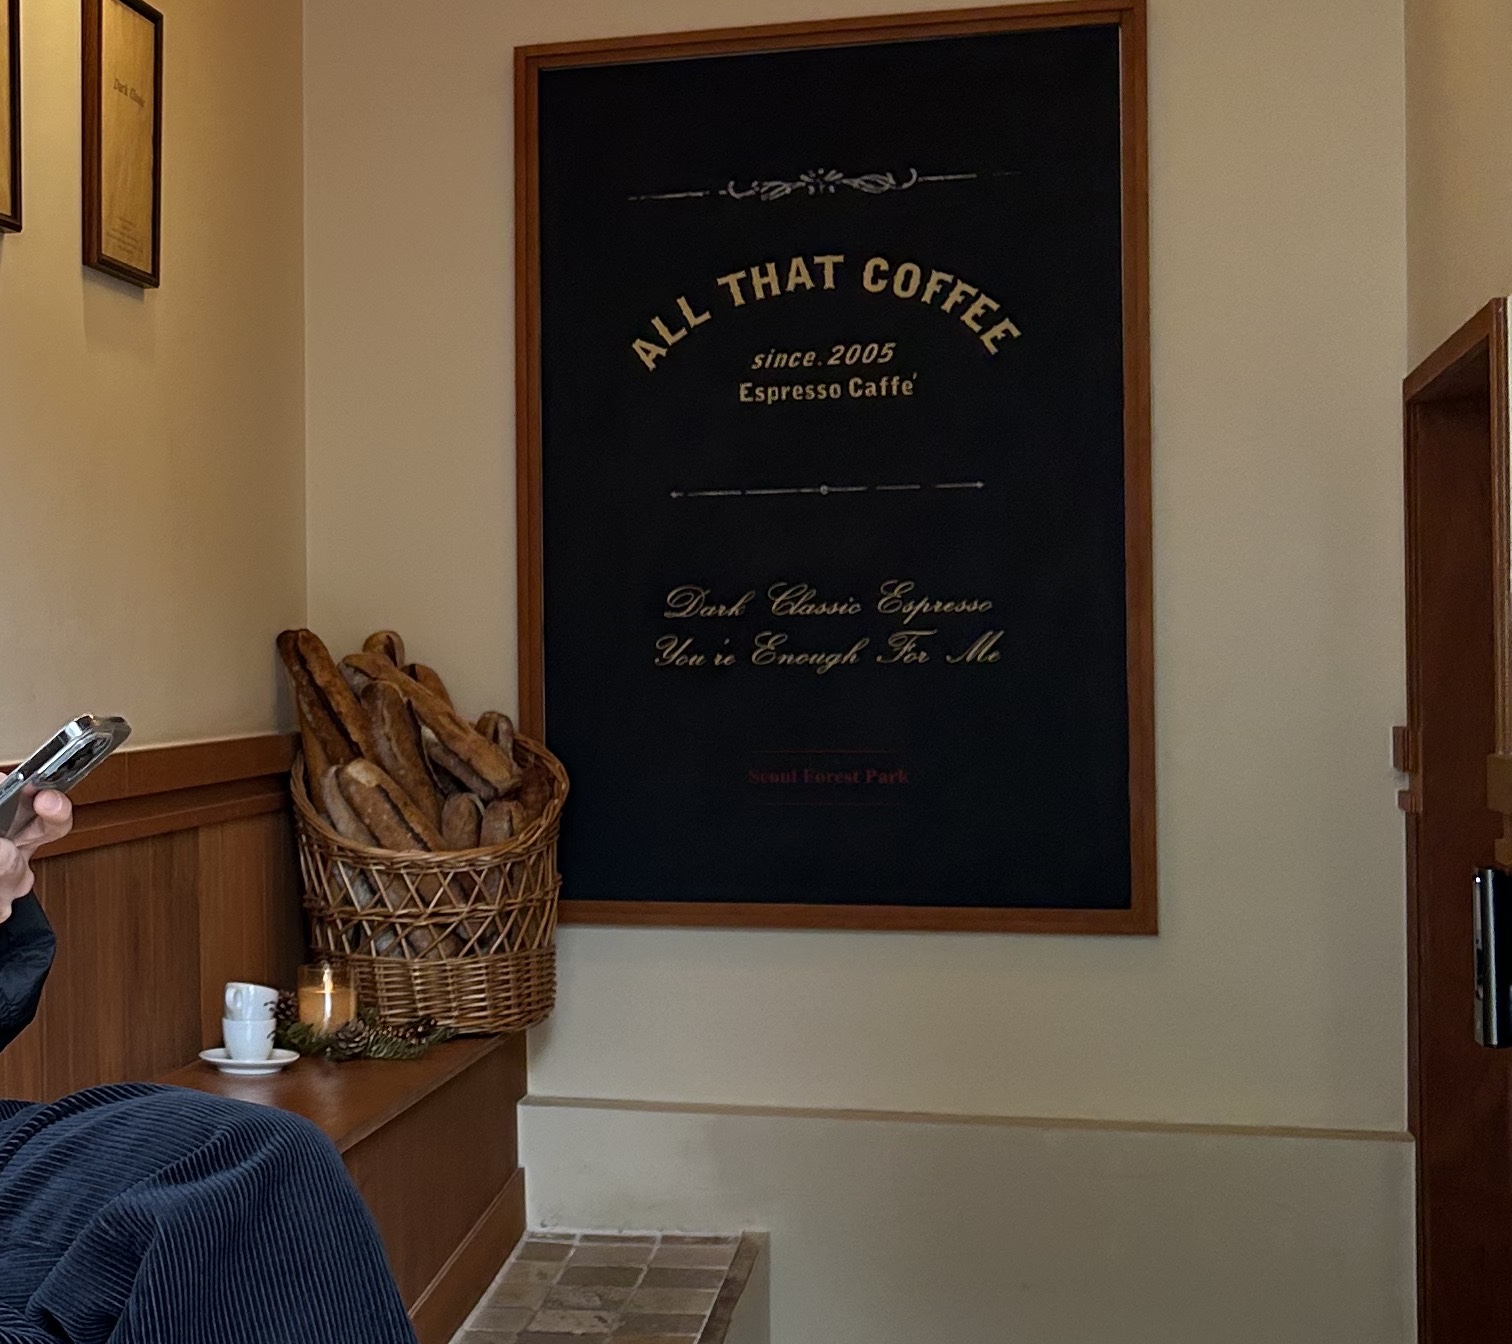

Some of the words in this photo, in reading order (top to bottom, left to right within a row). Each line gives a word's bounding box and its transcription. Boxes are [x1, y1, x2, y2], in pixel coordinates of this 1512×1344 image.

[631, 296, 711, 371] ALL
[717, 255, 845, 307] THAT
[862, 257, 1022, 355] COFFEE
[739, 382, 843, 405] Espresso
[663, 585, 756, 618] Dark
[767, 582, 862, 617] Classic
[877, 580, 993, 624] Espresso
[751, 631, 870, 674] Enough
[876, 629, 938, 666] For
[946, 630, 1006, 665] Me
[803, 768, 862, 784] Forest
[866, 769, 909, 784] Park
